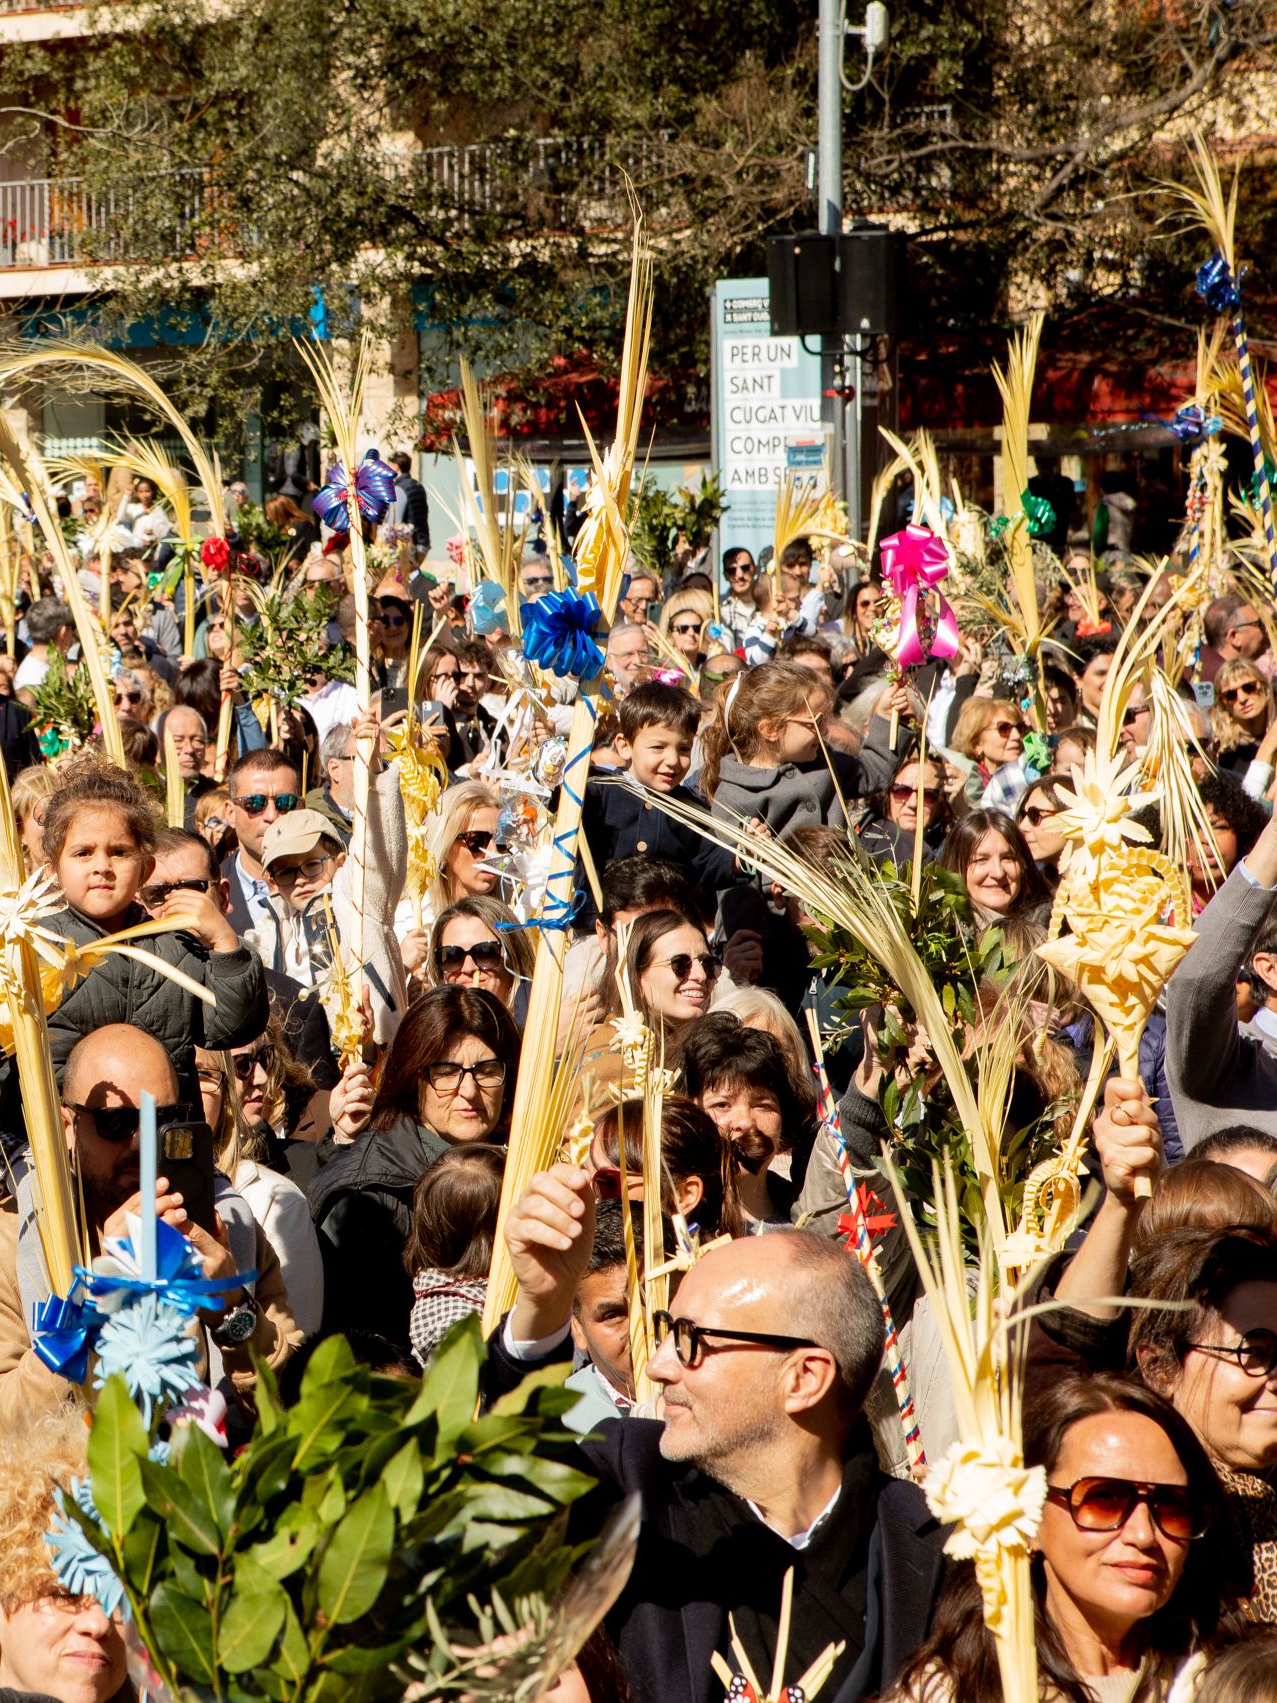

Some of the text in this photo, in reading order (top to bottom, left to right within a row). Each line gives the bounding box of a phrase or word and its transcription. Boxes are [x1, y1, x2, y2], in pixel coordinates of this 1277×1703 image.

[731, 343, 791, 363] PER UN
[730, 375, 774, 394] SANT
[730, 405, 787, 424] CUGAT
[730, 436, 787, 454] COMP
[731, 468, 768, 485] AMB
